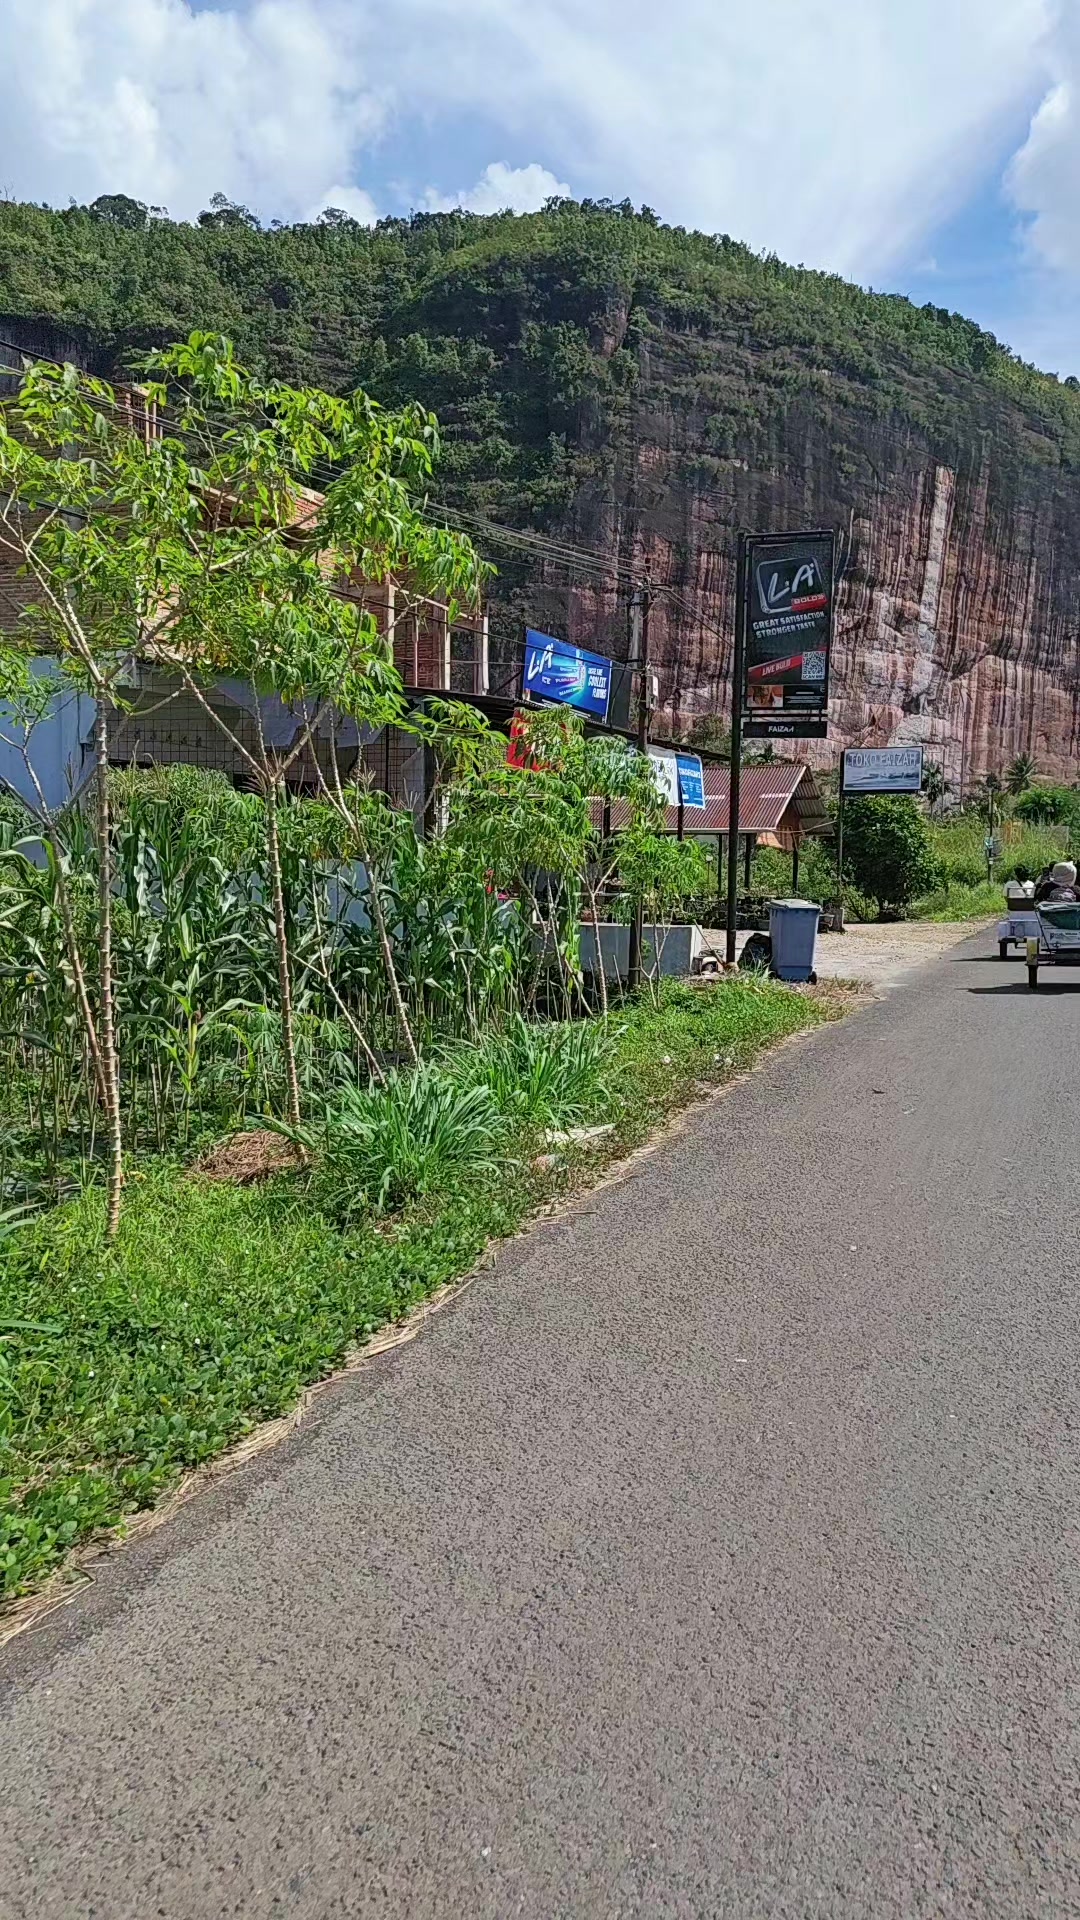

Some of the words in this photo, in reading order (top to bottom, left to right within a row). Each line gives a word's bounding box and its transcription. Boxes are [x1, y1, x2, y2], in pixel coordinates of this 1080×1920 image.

[780, 610, 825, 625] SATISFACTION
[752, 618, 780, 631] GREAT
[797, 621, 816, 631] TASTE
[755, 624, 797, 639] STRONGER
[762, 665, 776, 676] LIVE
[541, 675, 552, 685] ICE
[849, 753, 877, 767] TOKO
